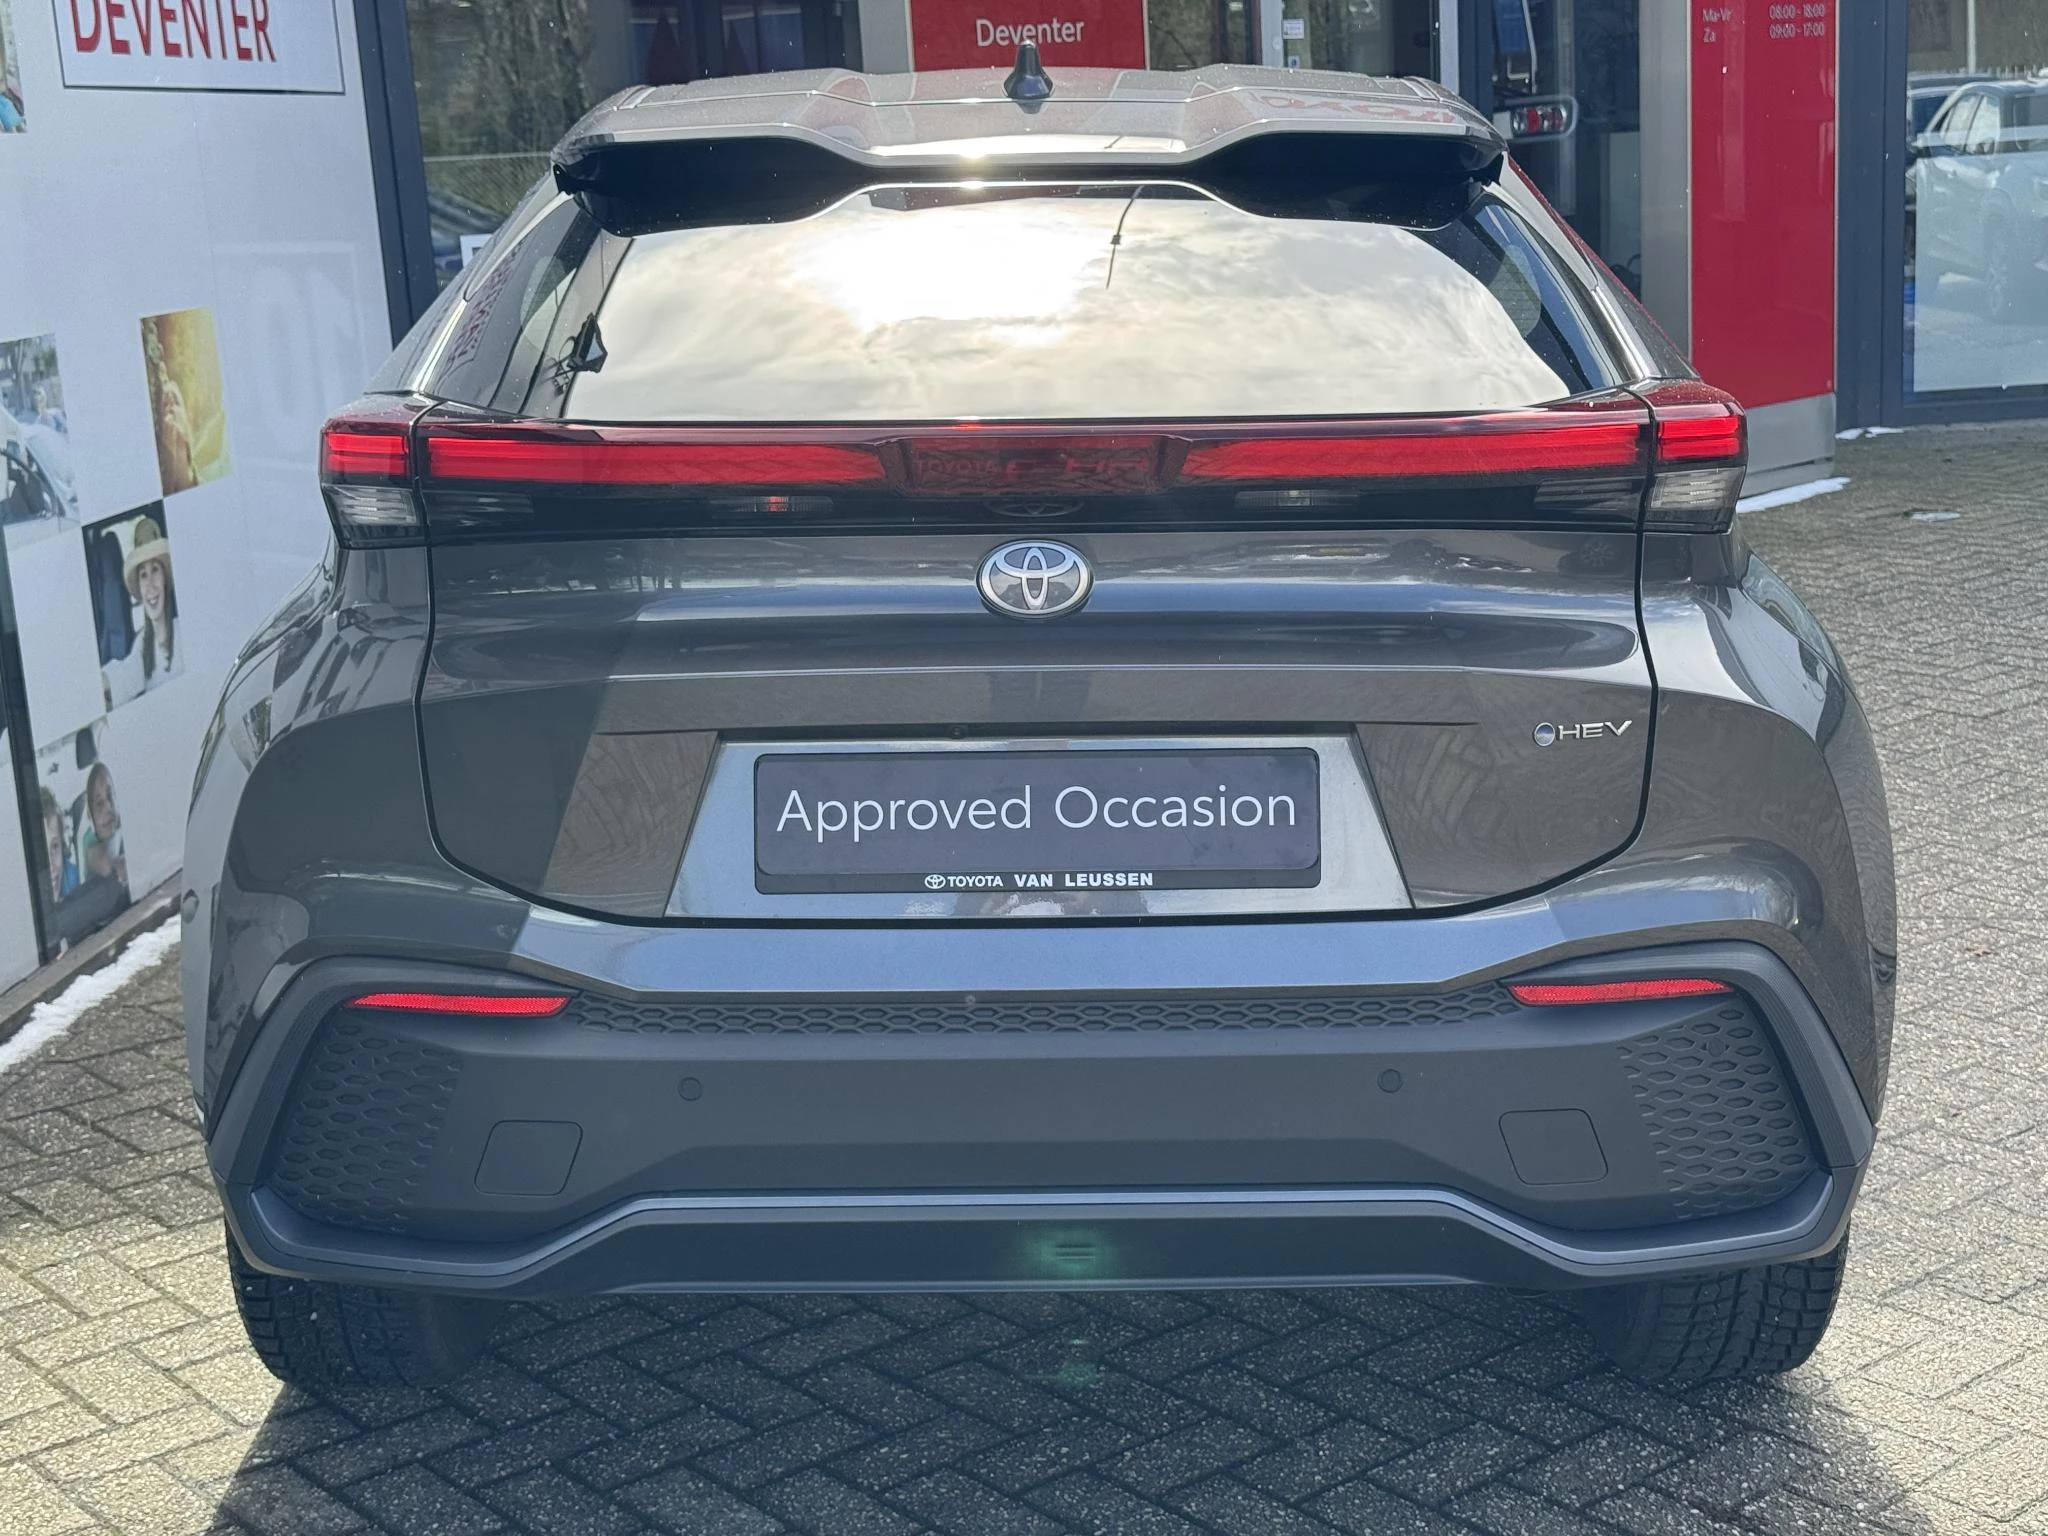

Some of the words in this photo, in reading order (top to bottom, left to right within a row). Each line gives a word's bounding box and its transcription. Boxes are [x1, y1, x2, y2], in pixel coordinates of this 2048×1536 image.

[975, 17, 1085, 47] Deventer
[1703, 26, 1716, 43] Za
[1558, 720, 1632, 740] HEV
[776, 785, 1031, 842] Approved
[1054, 785, 1296, 829] Occasion
[949, 875, 1004, 887] TOYOTA
[1013, 874, 1053, 887] VAN
[1064, 873, 1153, 887] LEUSSEN
